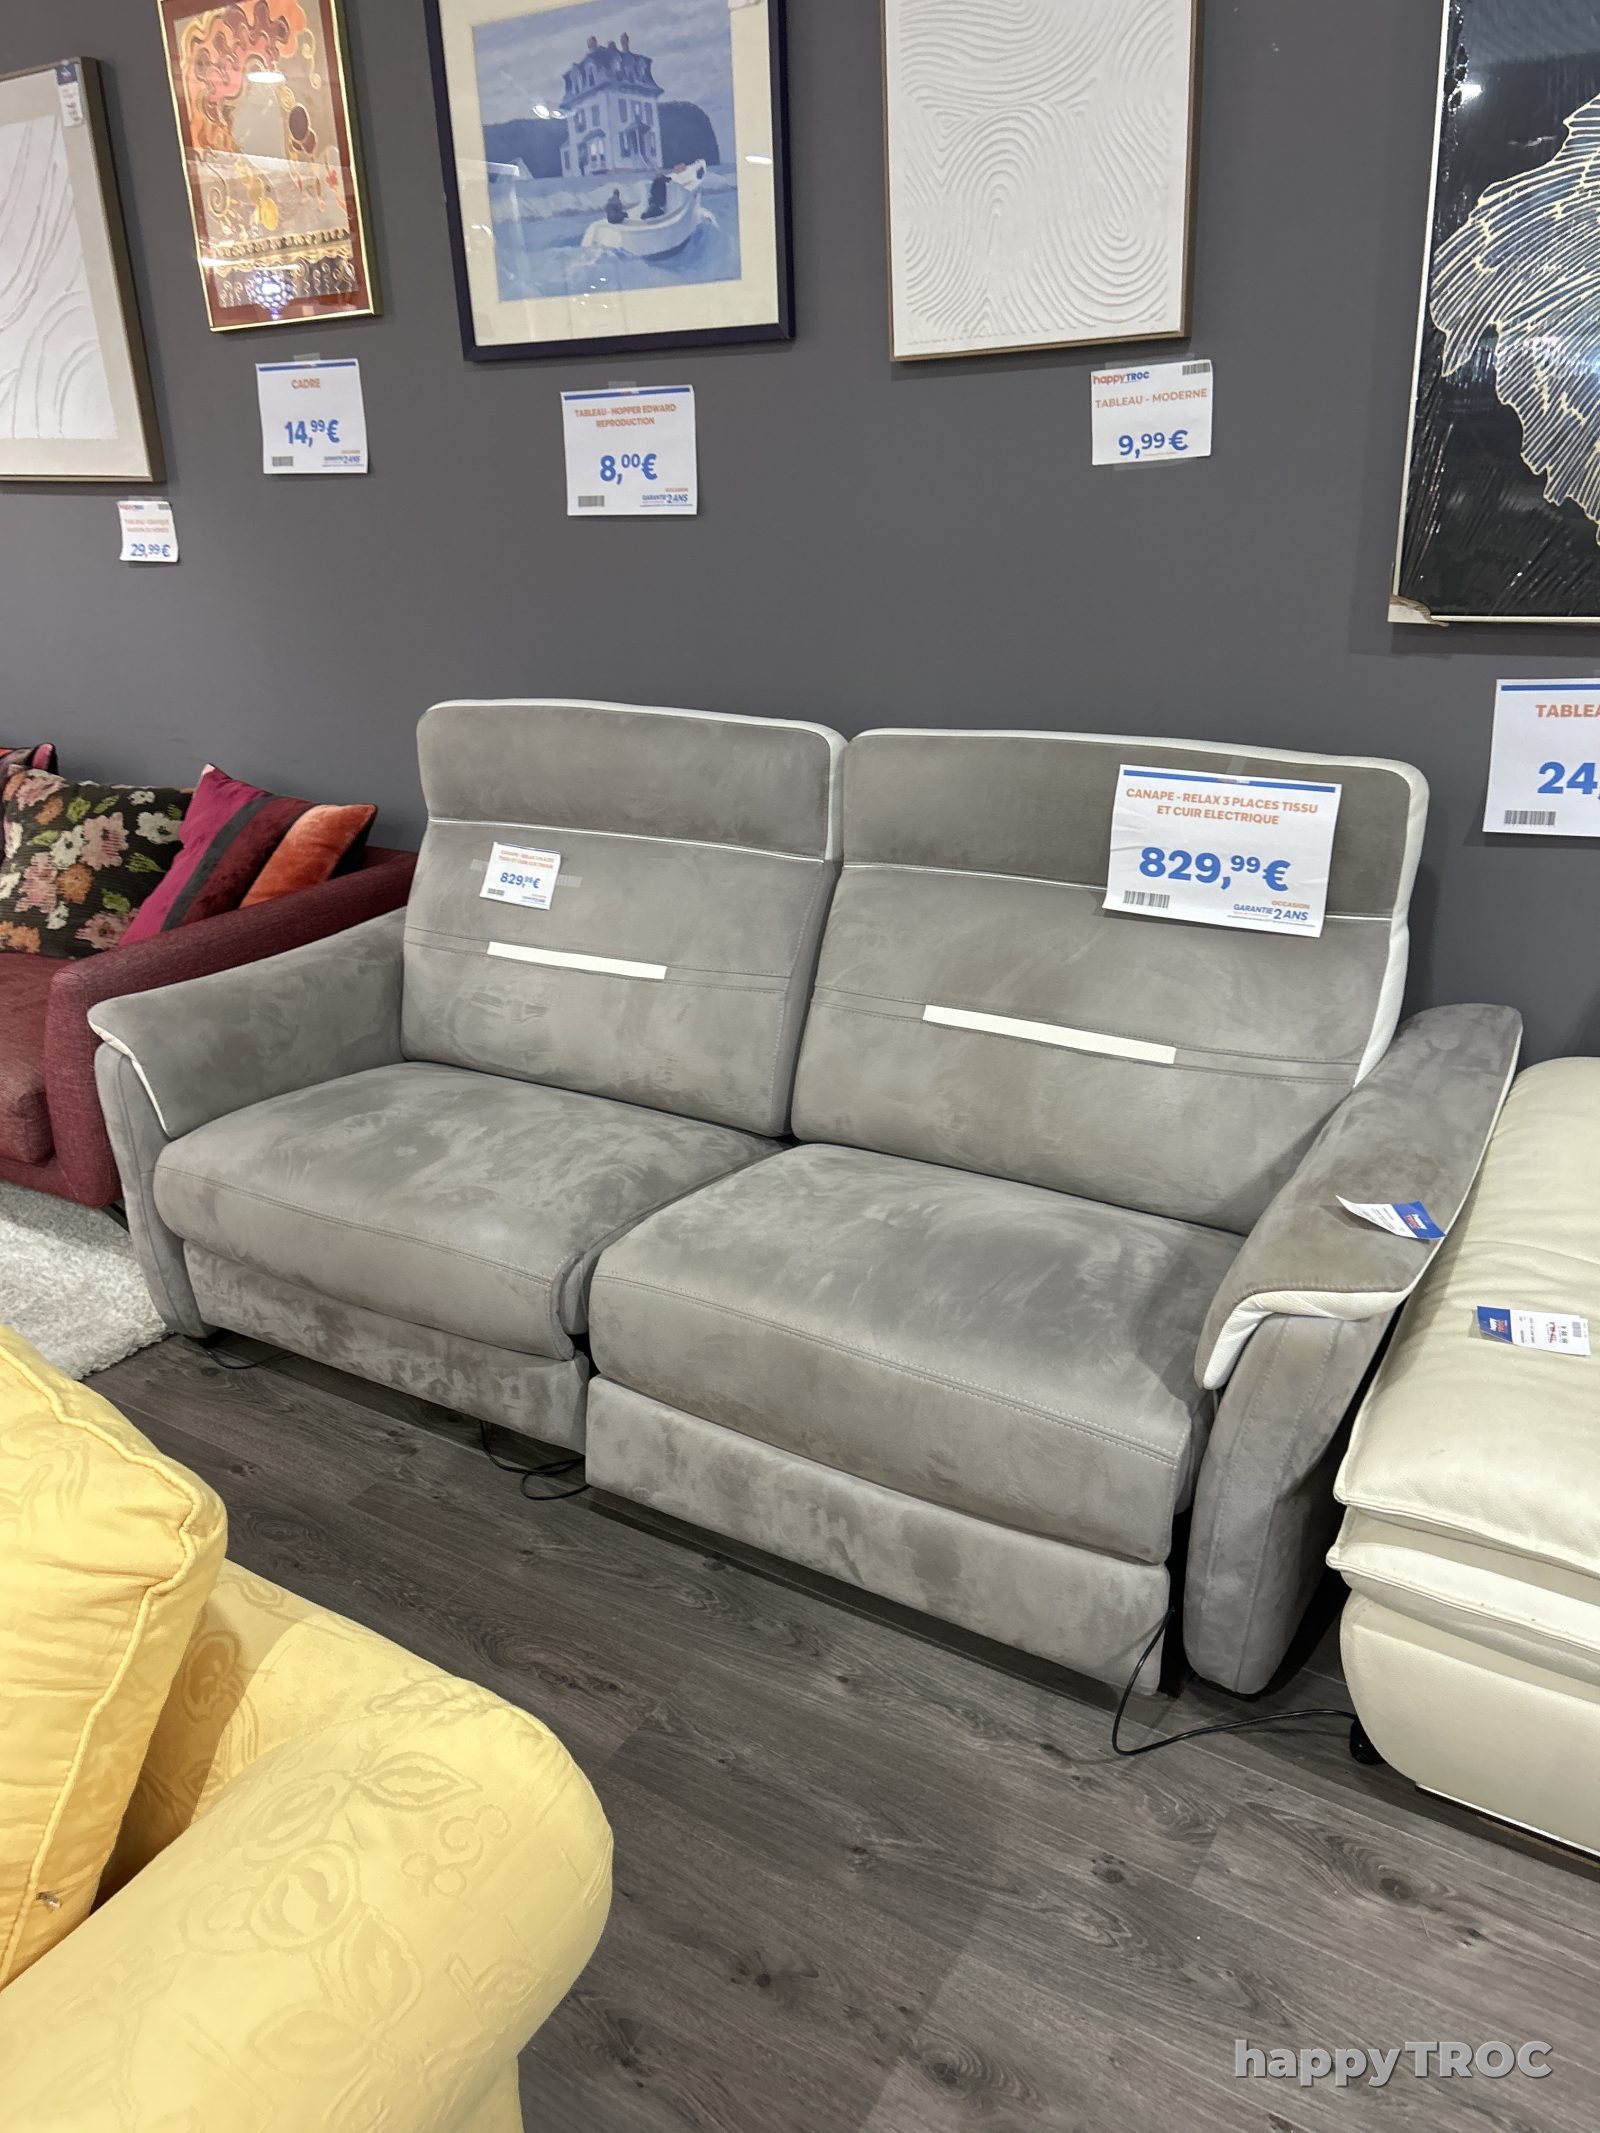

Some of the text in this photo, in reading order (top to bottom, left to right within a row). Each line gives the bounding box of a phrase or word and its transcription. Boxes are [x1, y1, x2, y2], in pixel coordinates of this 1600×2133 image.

[291, 378, 321, 389] CADRE
[1093, 371, 1150, 385] happyTROC
[1095, 395, 1143, 409] TABLEAU
[1152, 388, 1208, 403] MODERNE
[575, 407, 607, 417] TABLEAU
[611, 405, 641, 416] HOPPER
[642, 403, 677, 414] EDWARD
[596, 417, 655, 428] REPRODUCTION
[1126, 788, 1175, 802] CANAPE
[1183, 792, 1221, 806] RELAX
[1222, 795, 1231, 806] 3
[1232, 796, 1280, 811] PLACES
[1282, 800, 1319, 815] TISSU
[1156, 805, 1280, 826] ET CUIR ELECTRIQUE
[1271, 899, 1311, 910] OCCASION
[1232, 903, 1274, 916] GARANTIE
[1273, 908, 1283, 920] 2
[1283, 909, 1309, 922] ANS
